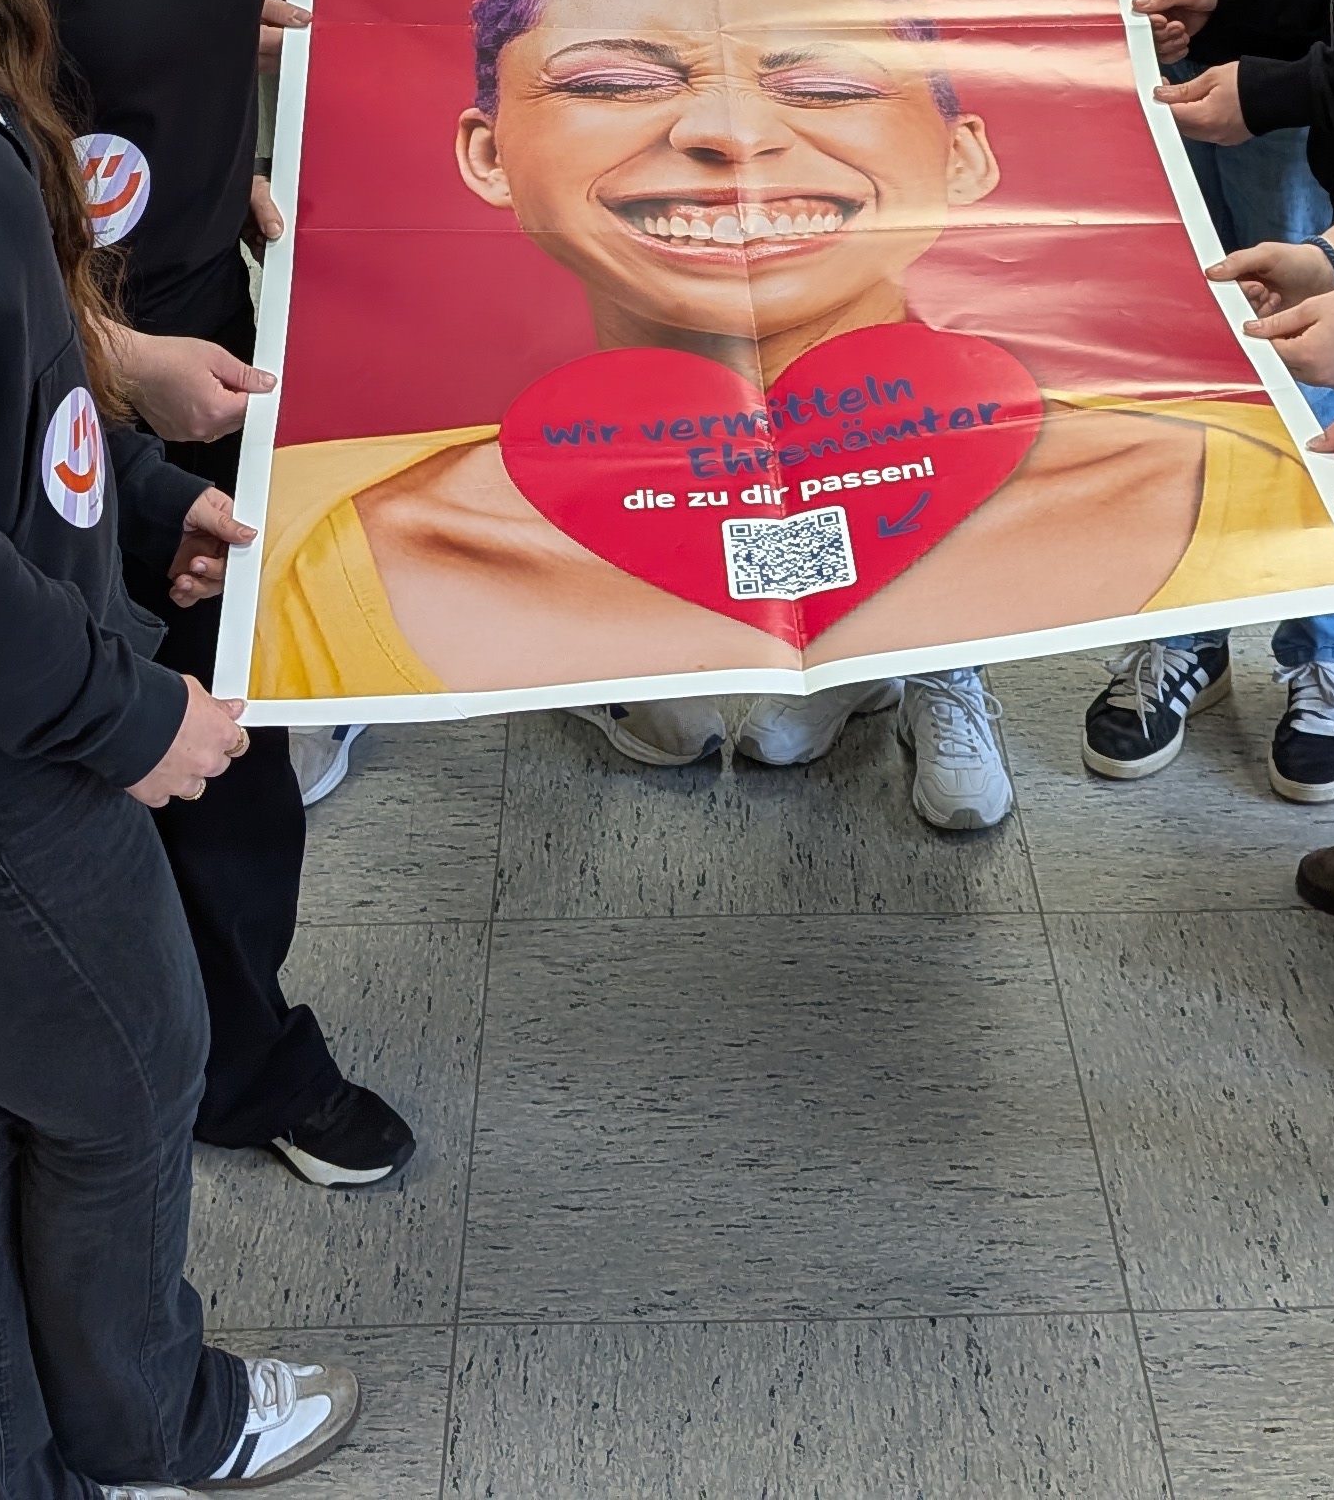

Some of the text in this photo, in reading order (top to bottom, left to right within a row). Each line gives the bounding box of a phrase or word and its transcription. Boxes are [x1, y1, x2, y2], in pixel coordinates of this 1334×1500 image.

[640, 375, 915, 443] vermitteln
[687, 402, 1002, 479] Ehrenämter
[623, 456, 935, 510] die zu dir passen!
